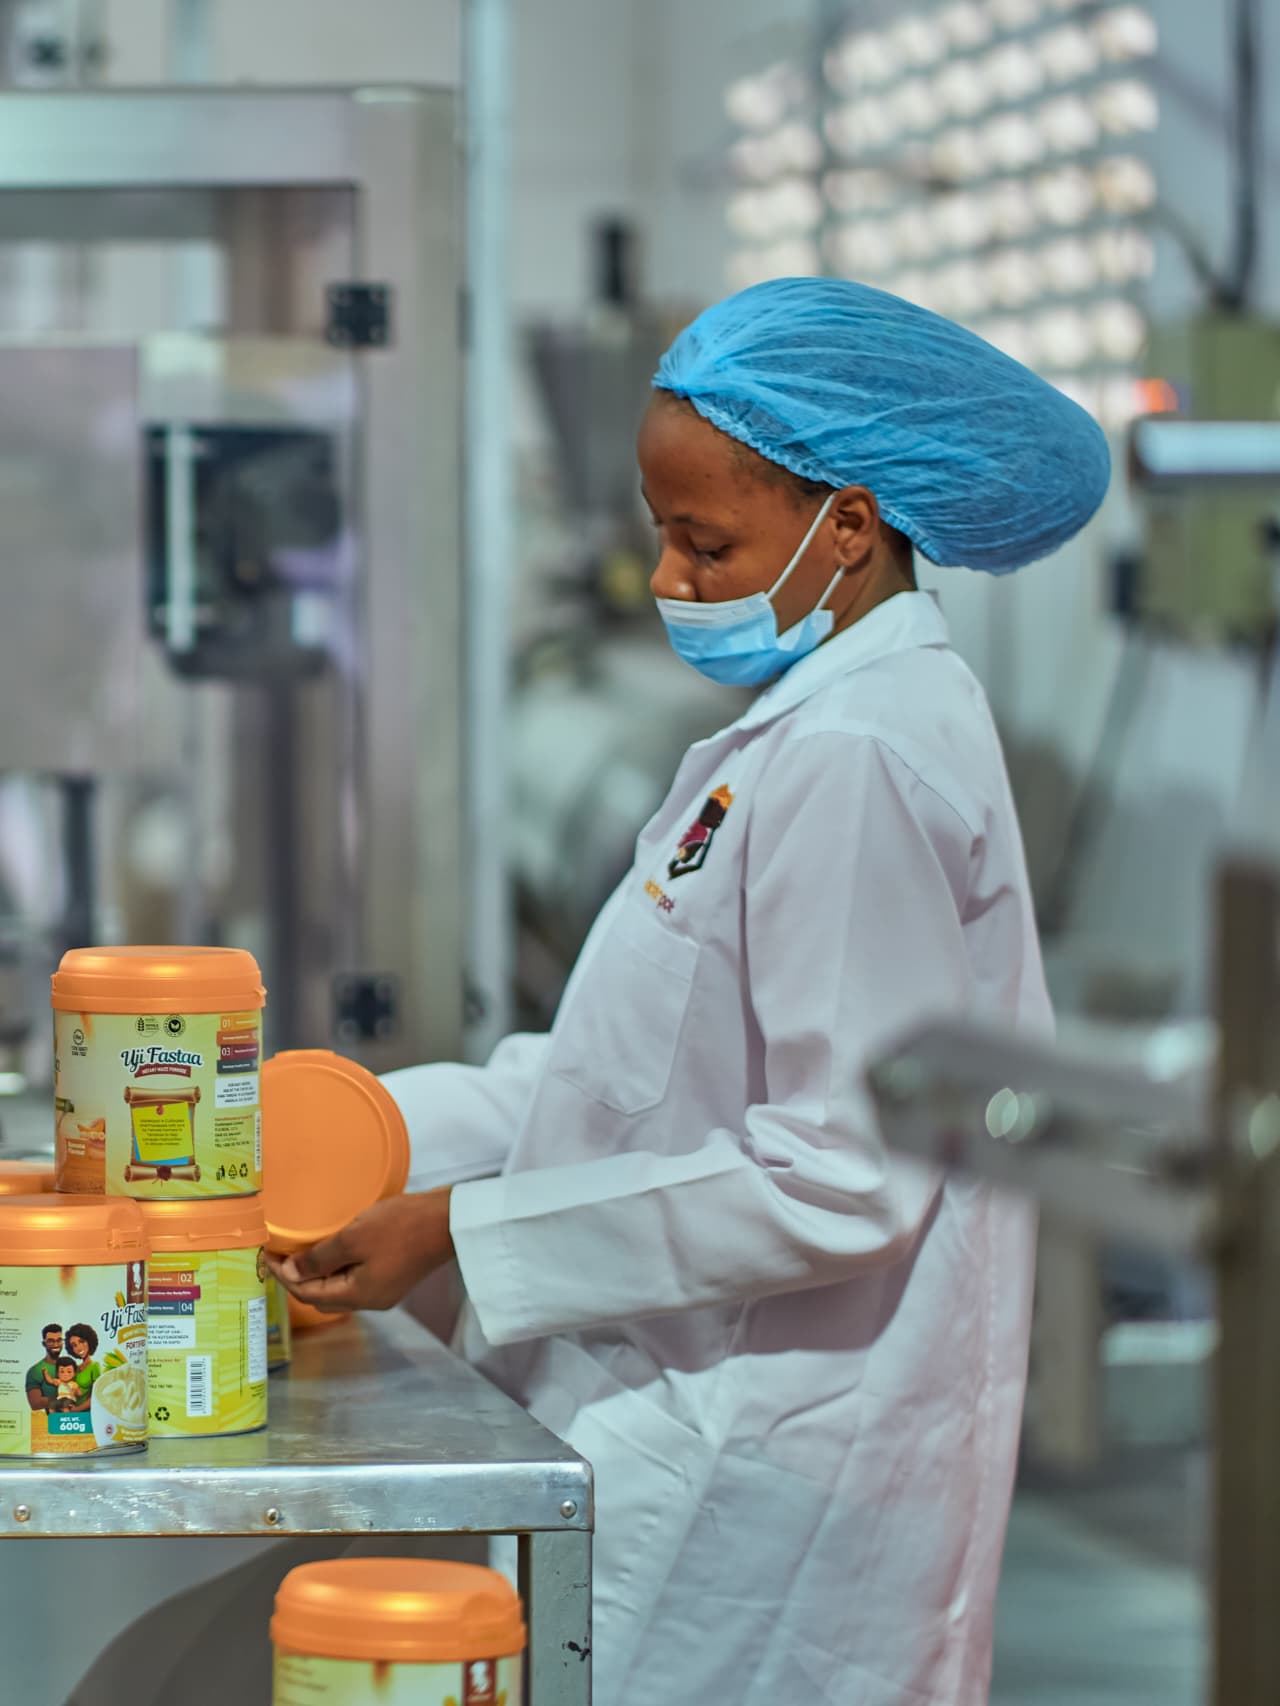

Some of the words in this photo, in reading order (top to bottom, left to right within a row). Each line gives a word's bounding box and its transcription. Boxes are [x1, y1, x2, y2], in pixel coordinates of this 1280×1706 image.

[221, 1047, 231, 1056] 03
[120, 1047, 145, 1073] Uji
[146, 1046, 203, 1066] Fastaa
[180, 1273, 192, 1283] 02
[181, 1302, 193, 1312] 04
[100, 1308, 123, 1339] Uji
[124, 1304, 146, 1325] Fast
[59, 1422, 86, 1433] 600g
